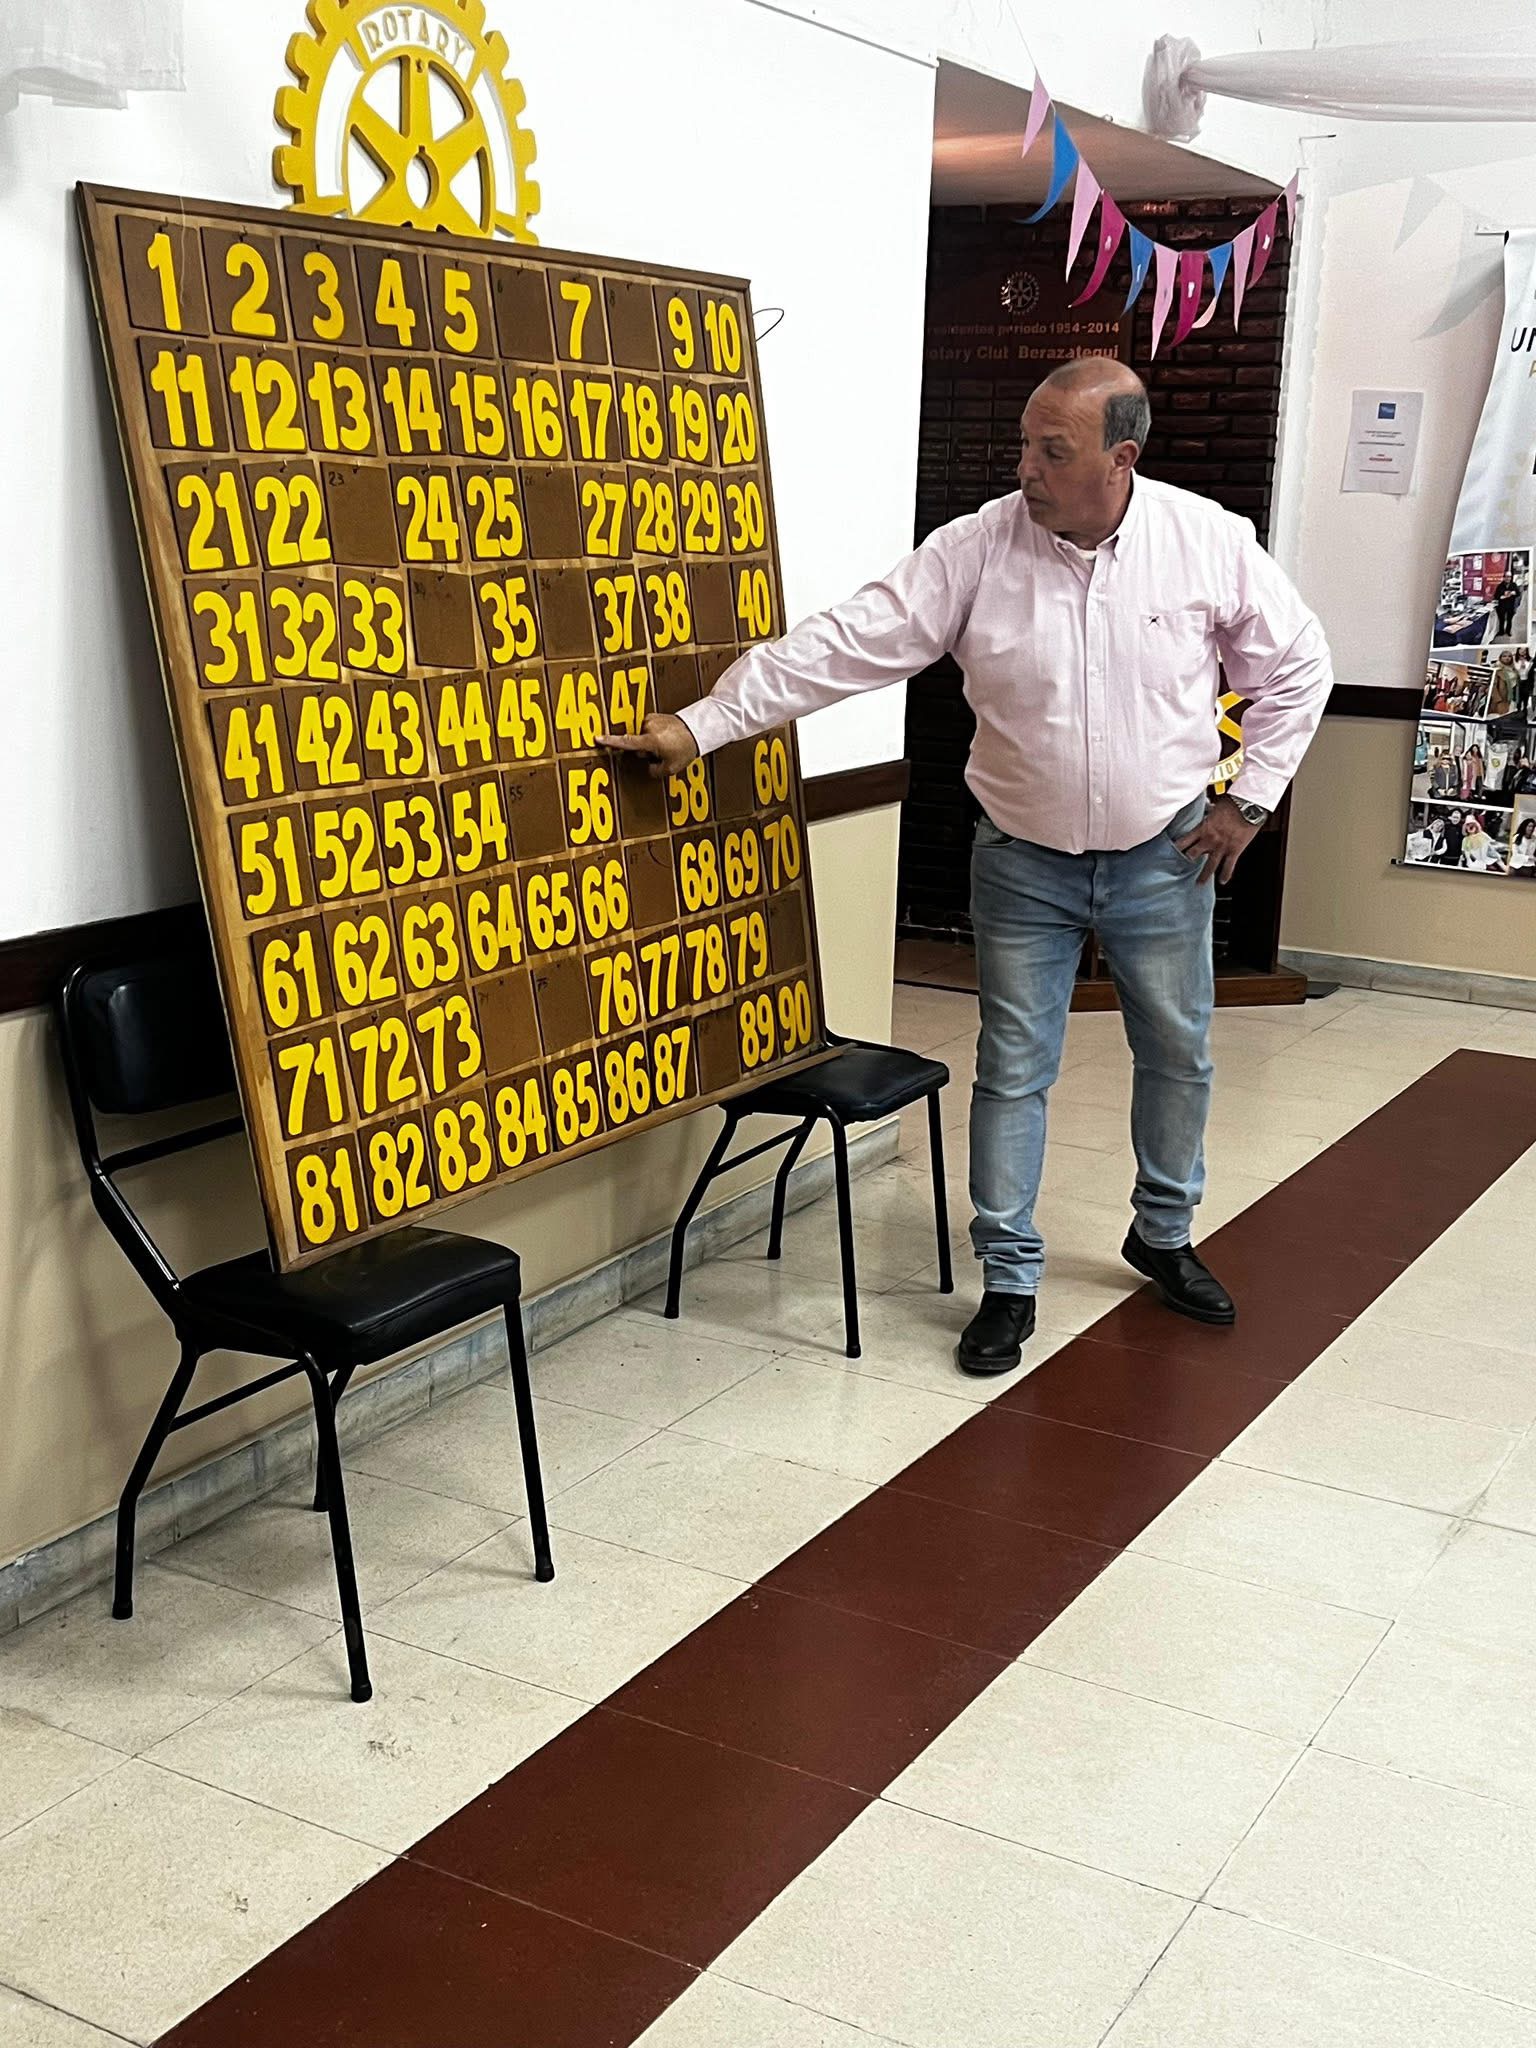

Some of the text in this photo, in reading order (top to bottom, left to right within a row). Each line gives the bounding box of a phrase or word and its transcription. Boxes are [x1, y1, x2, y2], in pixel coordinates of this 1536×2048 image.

[361, 9, 467, 66] ROTARY
[147, 233, 741, 373] 1 2 3 4 5 7 9 10
[926, 345, 972, 363] otary
[1049, 322, 1120, 335] 1954-2014
[150, 350, 756, 465] 11 12 13 14 15 16 17 18 19 20
[177, 471, 765, 570] 21 22 24 25 27 28 29 30
[193, 569, 772, 684] 31 32 33 35 37 38 40
[224, 666, 649, 799] 41 42 43 44 45 46 47
[241, 737, 788, 915] 51 52 53 54 56 58 60
[262, 813, 801, 1029] 61 62 63 64 65 66 68 69 70
[278, 911, 768, 1135] 71 72 73 76 77 78 79
[296, 979, 811, 1244] 81 82 83 84 85 86 87 89 90
